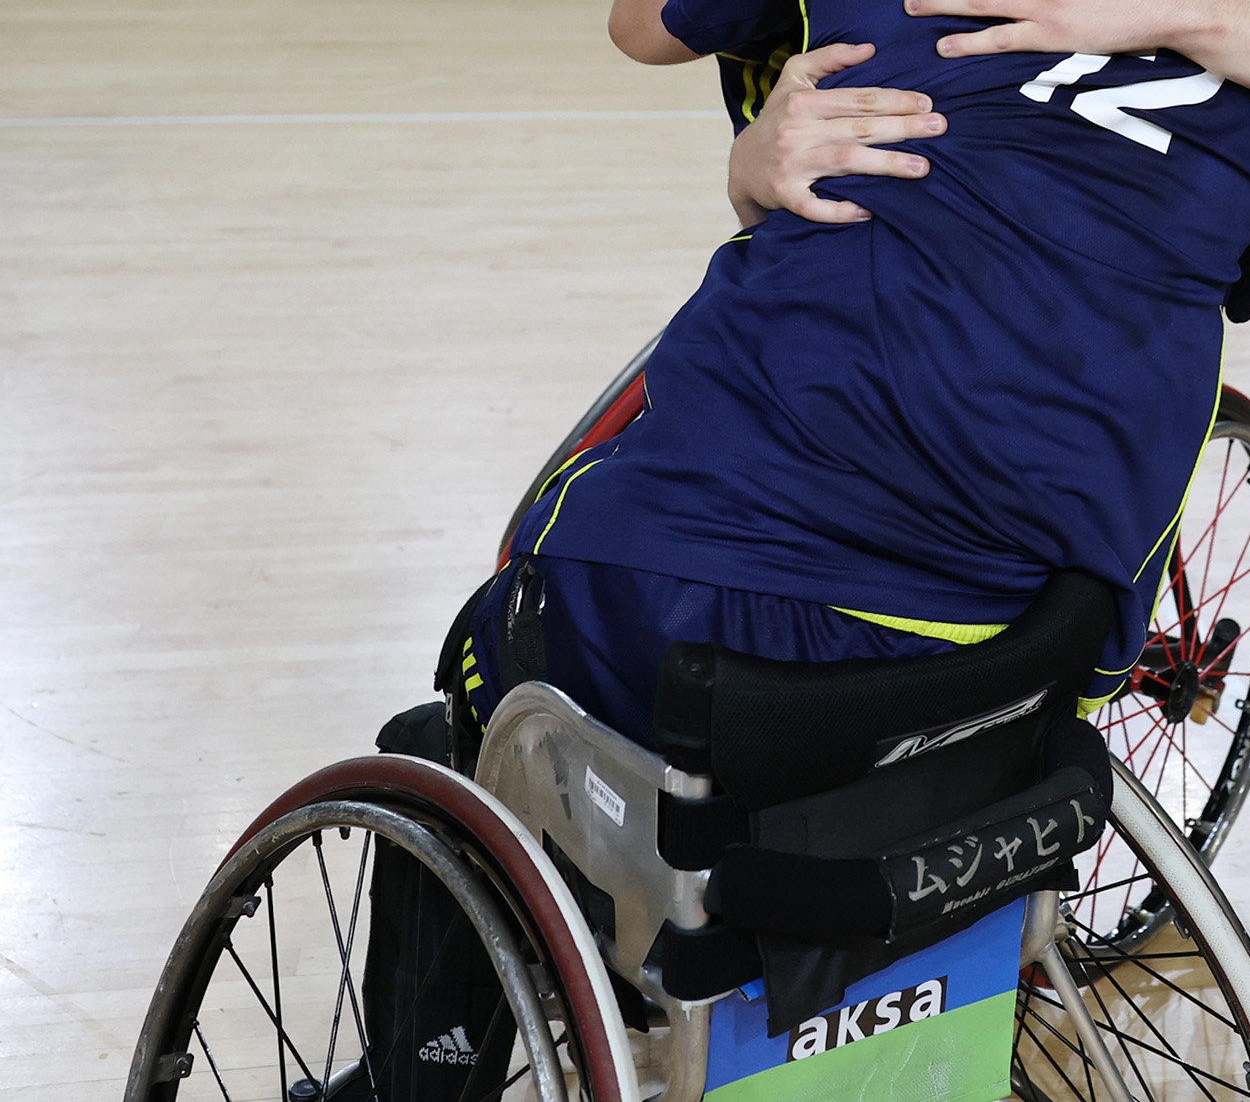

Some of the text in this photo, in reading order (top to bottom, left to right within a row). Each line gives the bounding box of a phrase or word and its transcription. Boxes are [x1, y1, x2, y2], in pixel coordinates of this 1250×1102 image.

[908, 799, 1095, 902] ムジャヒト
[419, 1046, 479, 1066] adidas
[791, 978, 943, 1061] aksa
